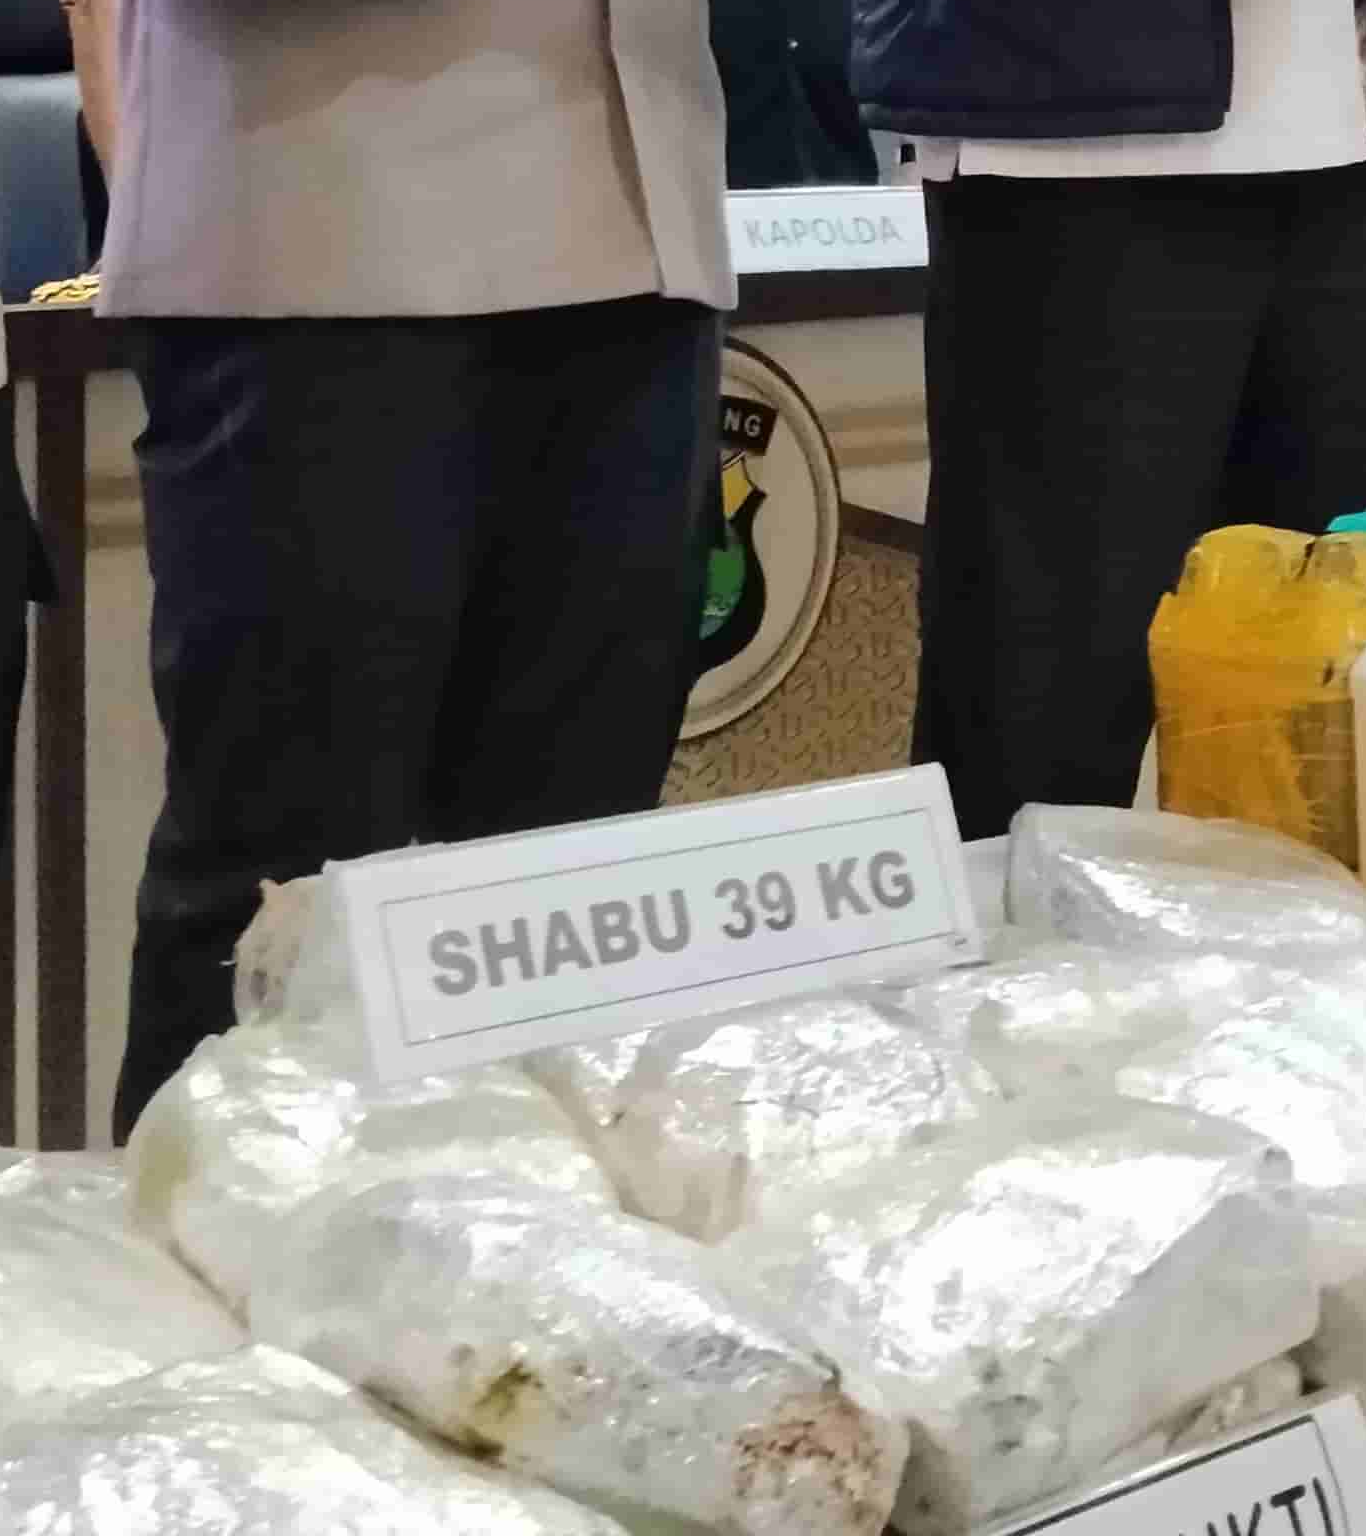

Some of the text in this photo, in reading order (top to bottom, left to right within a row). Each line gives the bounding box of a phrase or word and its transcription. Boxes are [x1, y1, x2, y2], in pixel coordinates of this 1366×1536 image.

[742, 215, 903, 249] KAPOLDA
[428, 849, 917, 996] SHABU 39 KG
